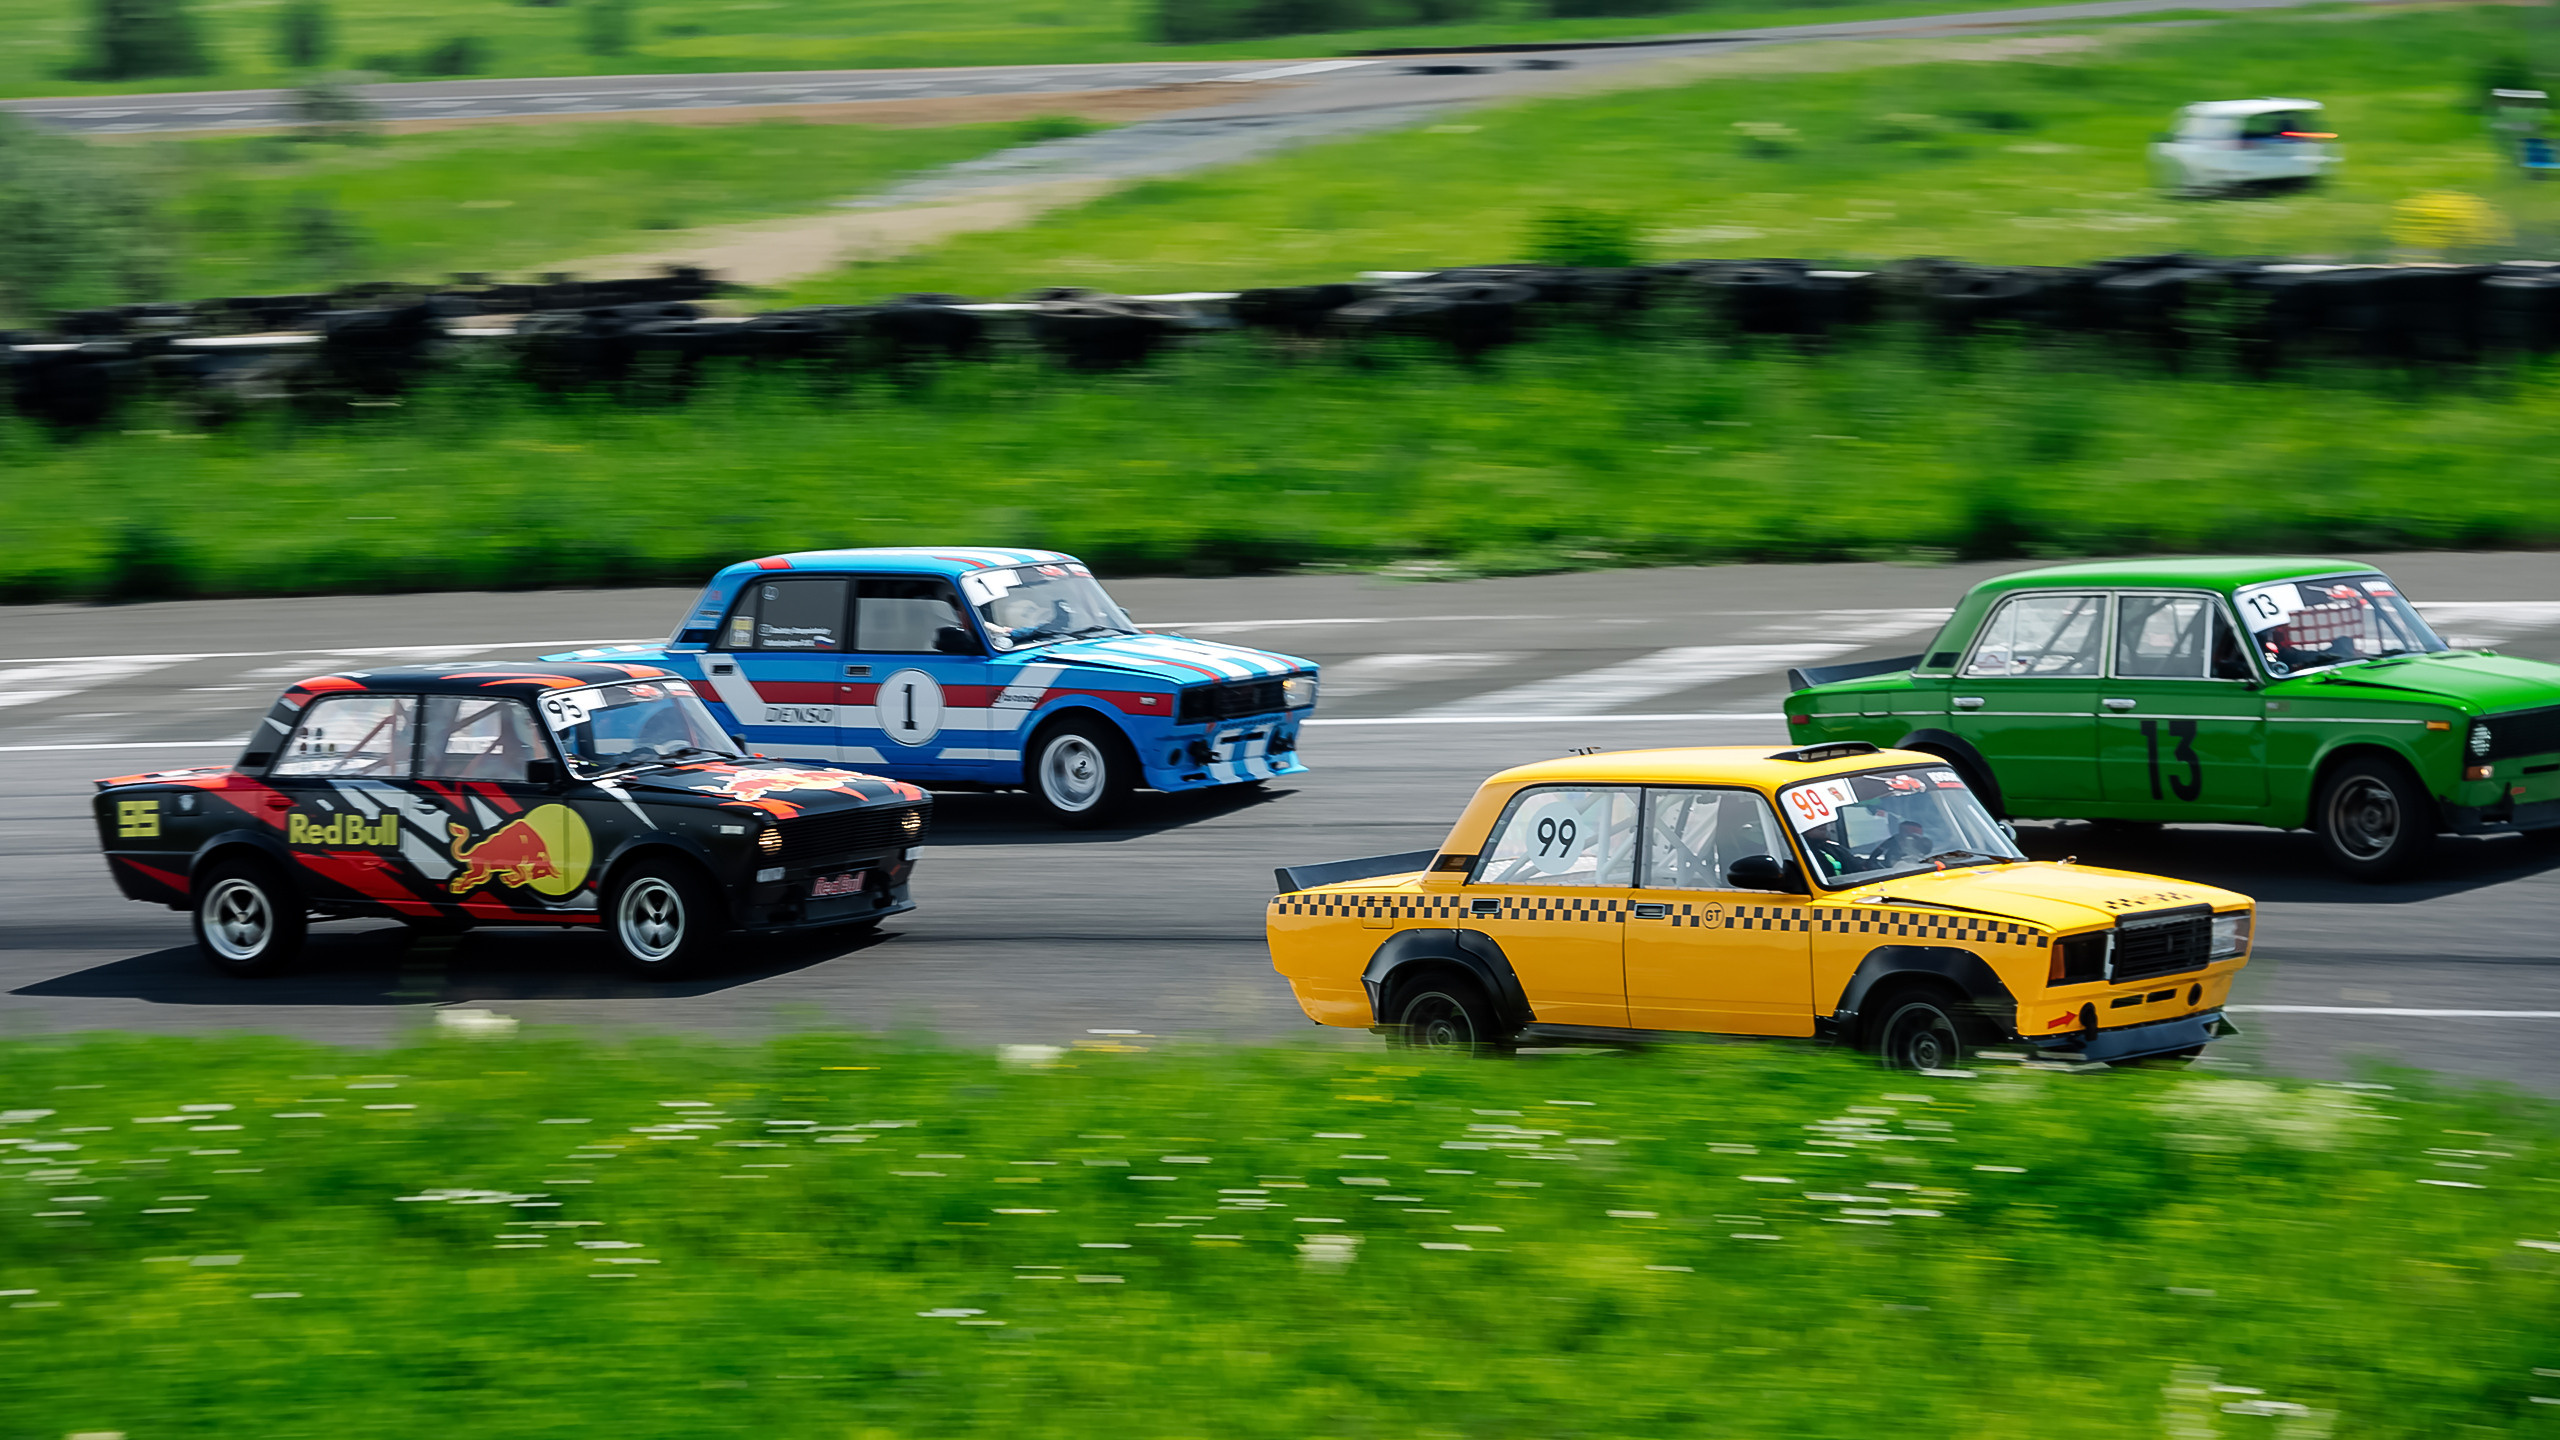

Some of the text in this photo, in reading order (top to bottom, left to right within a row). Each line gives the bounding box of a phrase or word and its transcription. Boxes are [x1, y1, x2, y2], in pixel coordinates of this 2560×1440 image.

[2248, 593, 2279, 619] 13
[547, 697, 582, 722] 95
[765, 706, 834, 724] DENSO
[901, 683, 919, 731] 1
[2140, 720, 2202, 802] 13
[117, 800, 160, 837] 95
[1791, 788, 1830, 820] 99
[1537, 817, 1576, 858] 99
[1705, 909, 1721, 921] GT
